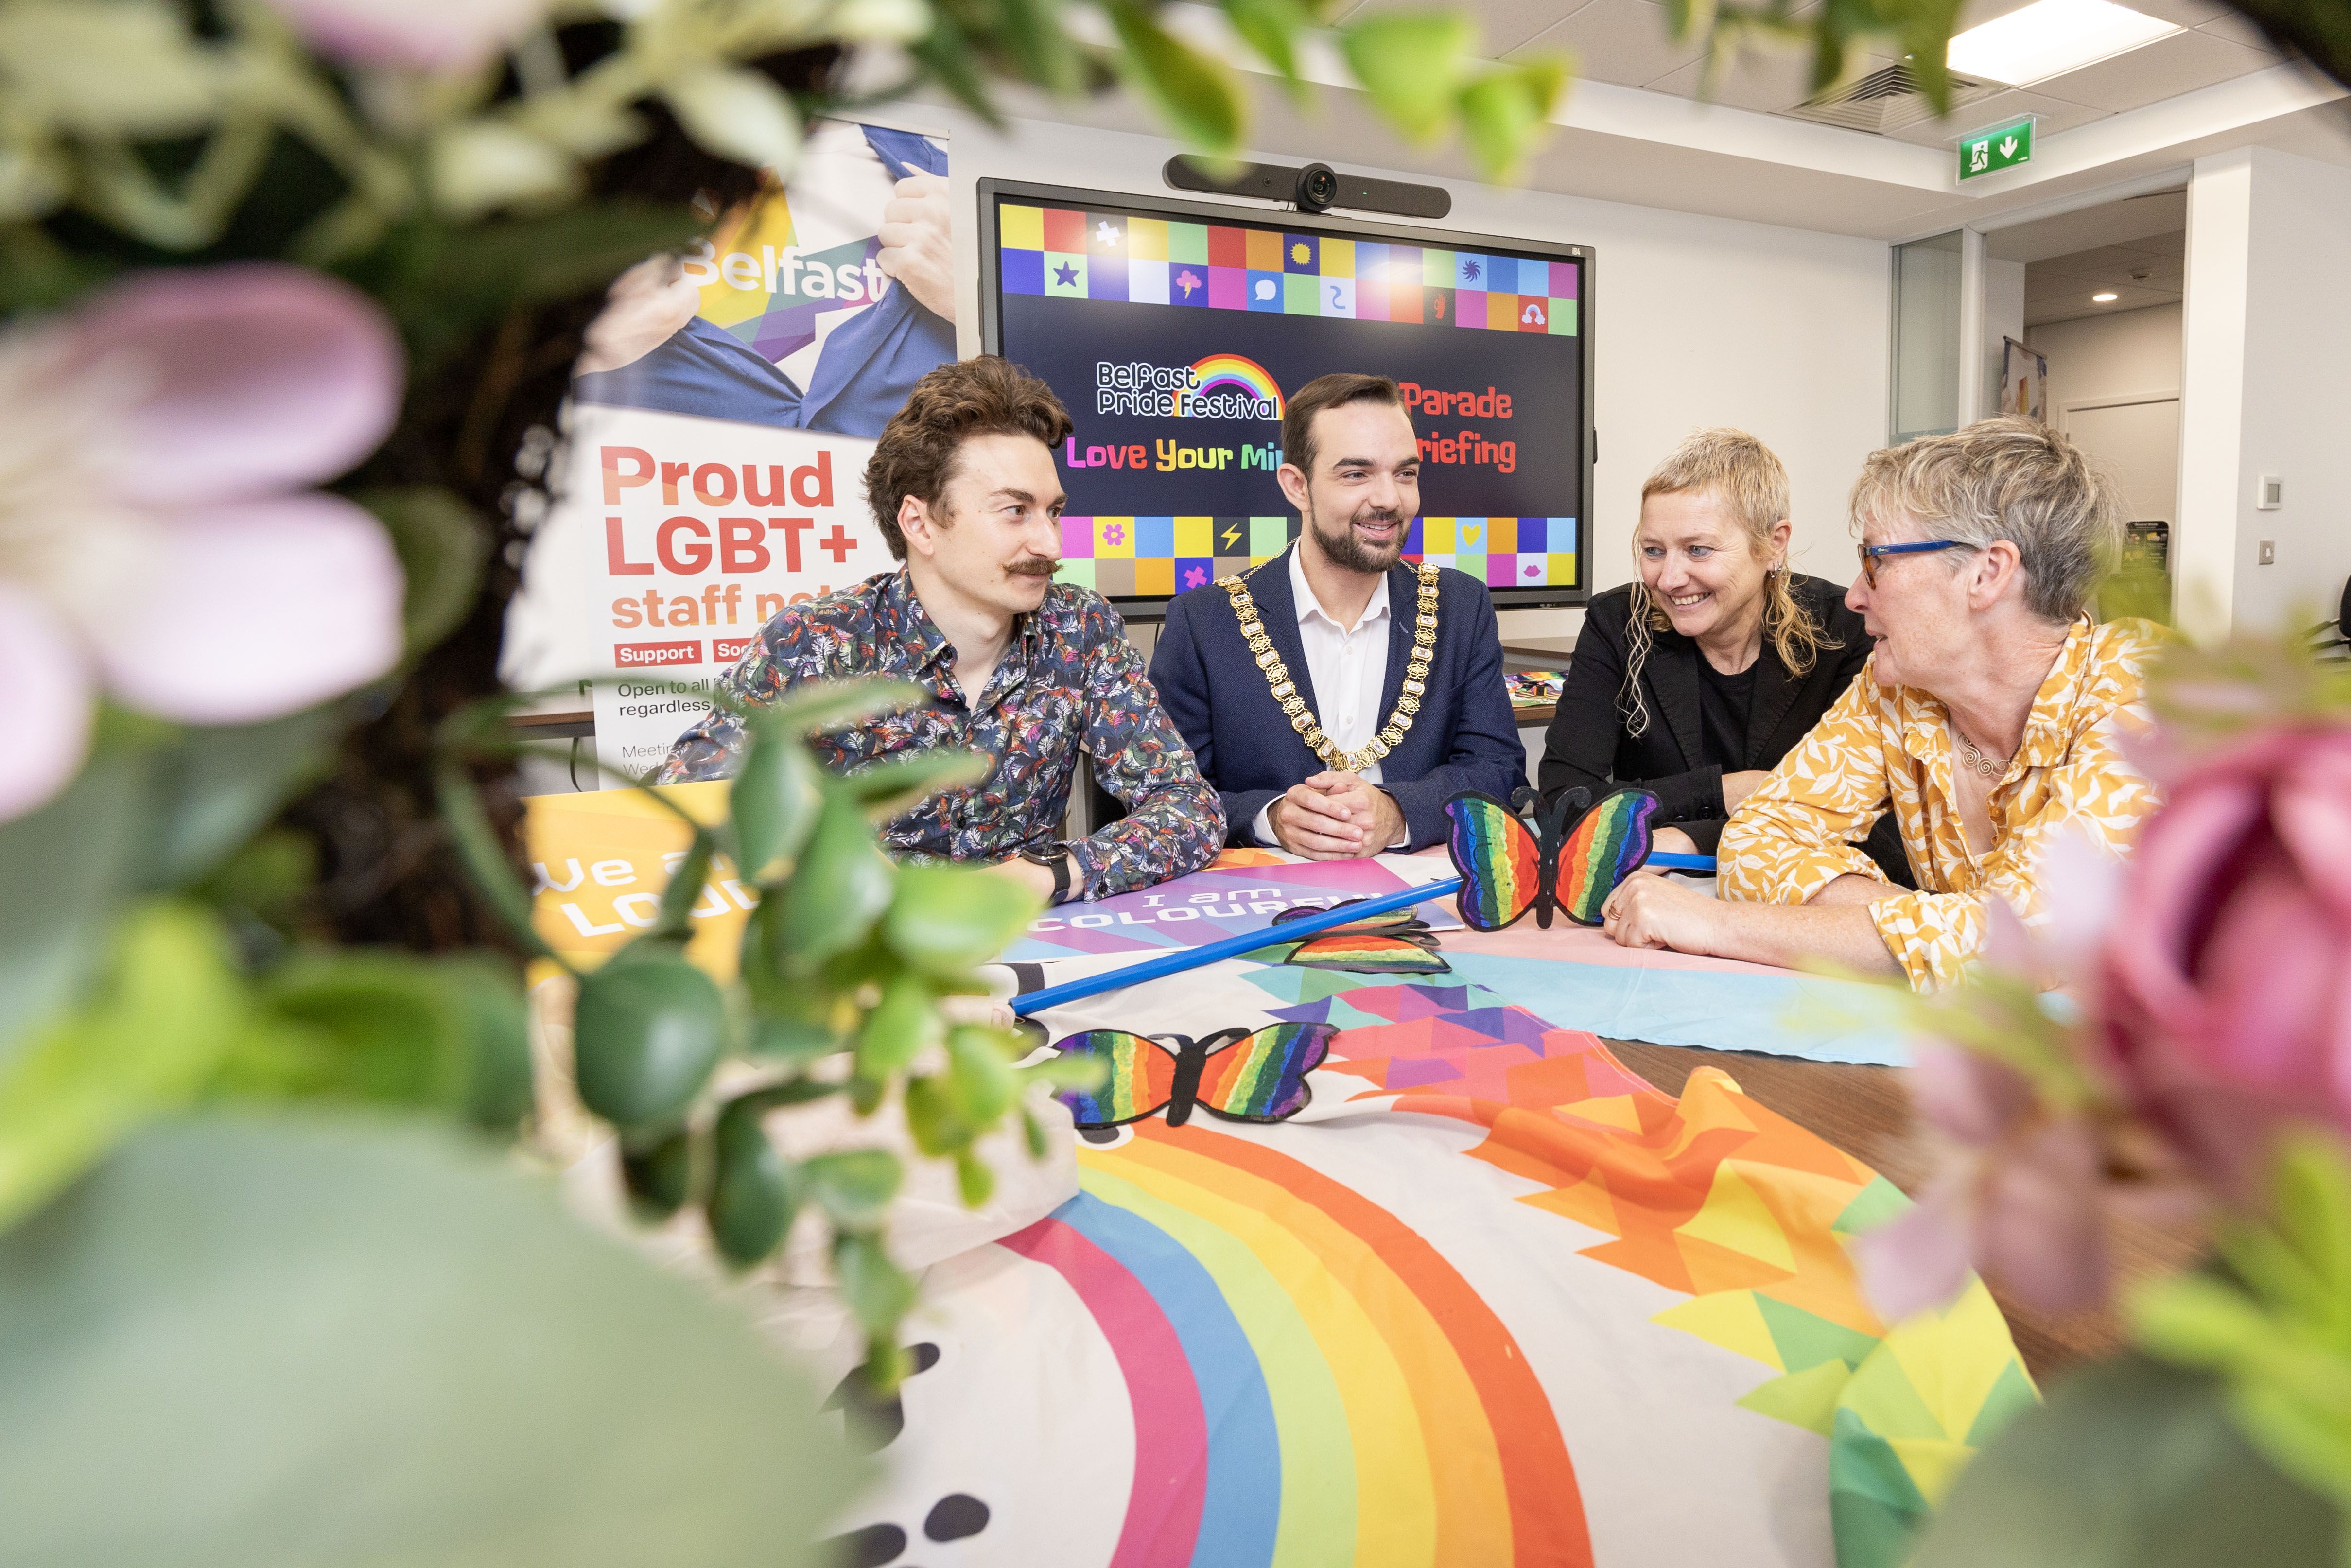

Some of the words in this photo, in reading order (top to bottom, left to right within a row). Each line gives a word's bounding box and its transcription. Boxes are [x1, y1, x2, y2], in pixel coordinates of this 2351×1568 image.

[679, 237, 887, 302] Belfast
[1097, 362, 1201, 390] Belfast
[1097, 388, 1175, 417] Pride
[1179, 394, 1279, 420] Festival
[1399, 382, 1513, 418] Parade
[1067, 437, 1148, 469] Love
[1156, 439, 1233, 471] Your
[601, 446, 834, 507] Proud
[605, 516, 857, 575] LGBT+
[612, 584, 742, 629] staff
[620, 645, 695, 663] Support
[618, 684, 665, 699] Open
[670, 681, 687, 694] to
[692, 679, 709, 691] all
[620, 700, 710, 718] regardless
[1143, 894, 1165, 907] I
[1188, 888, 1282, 904] am
